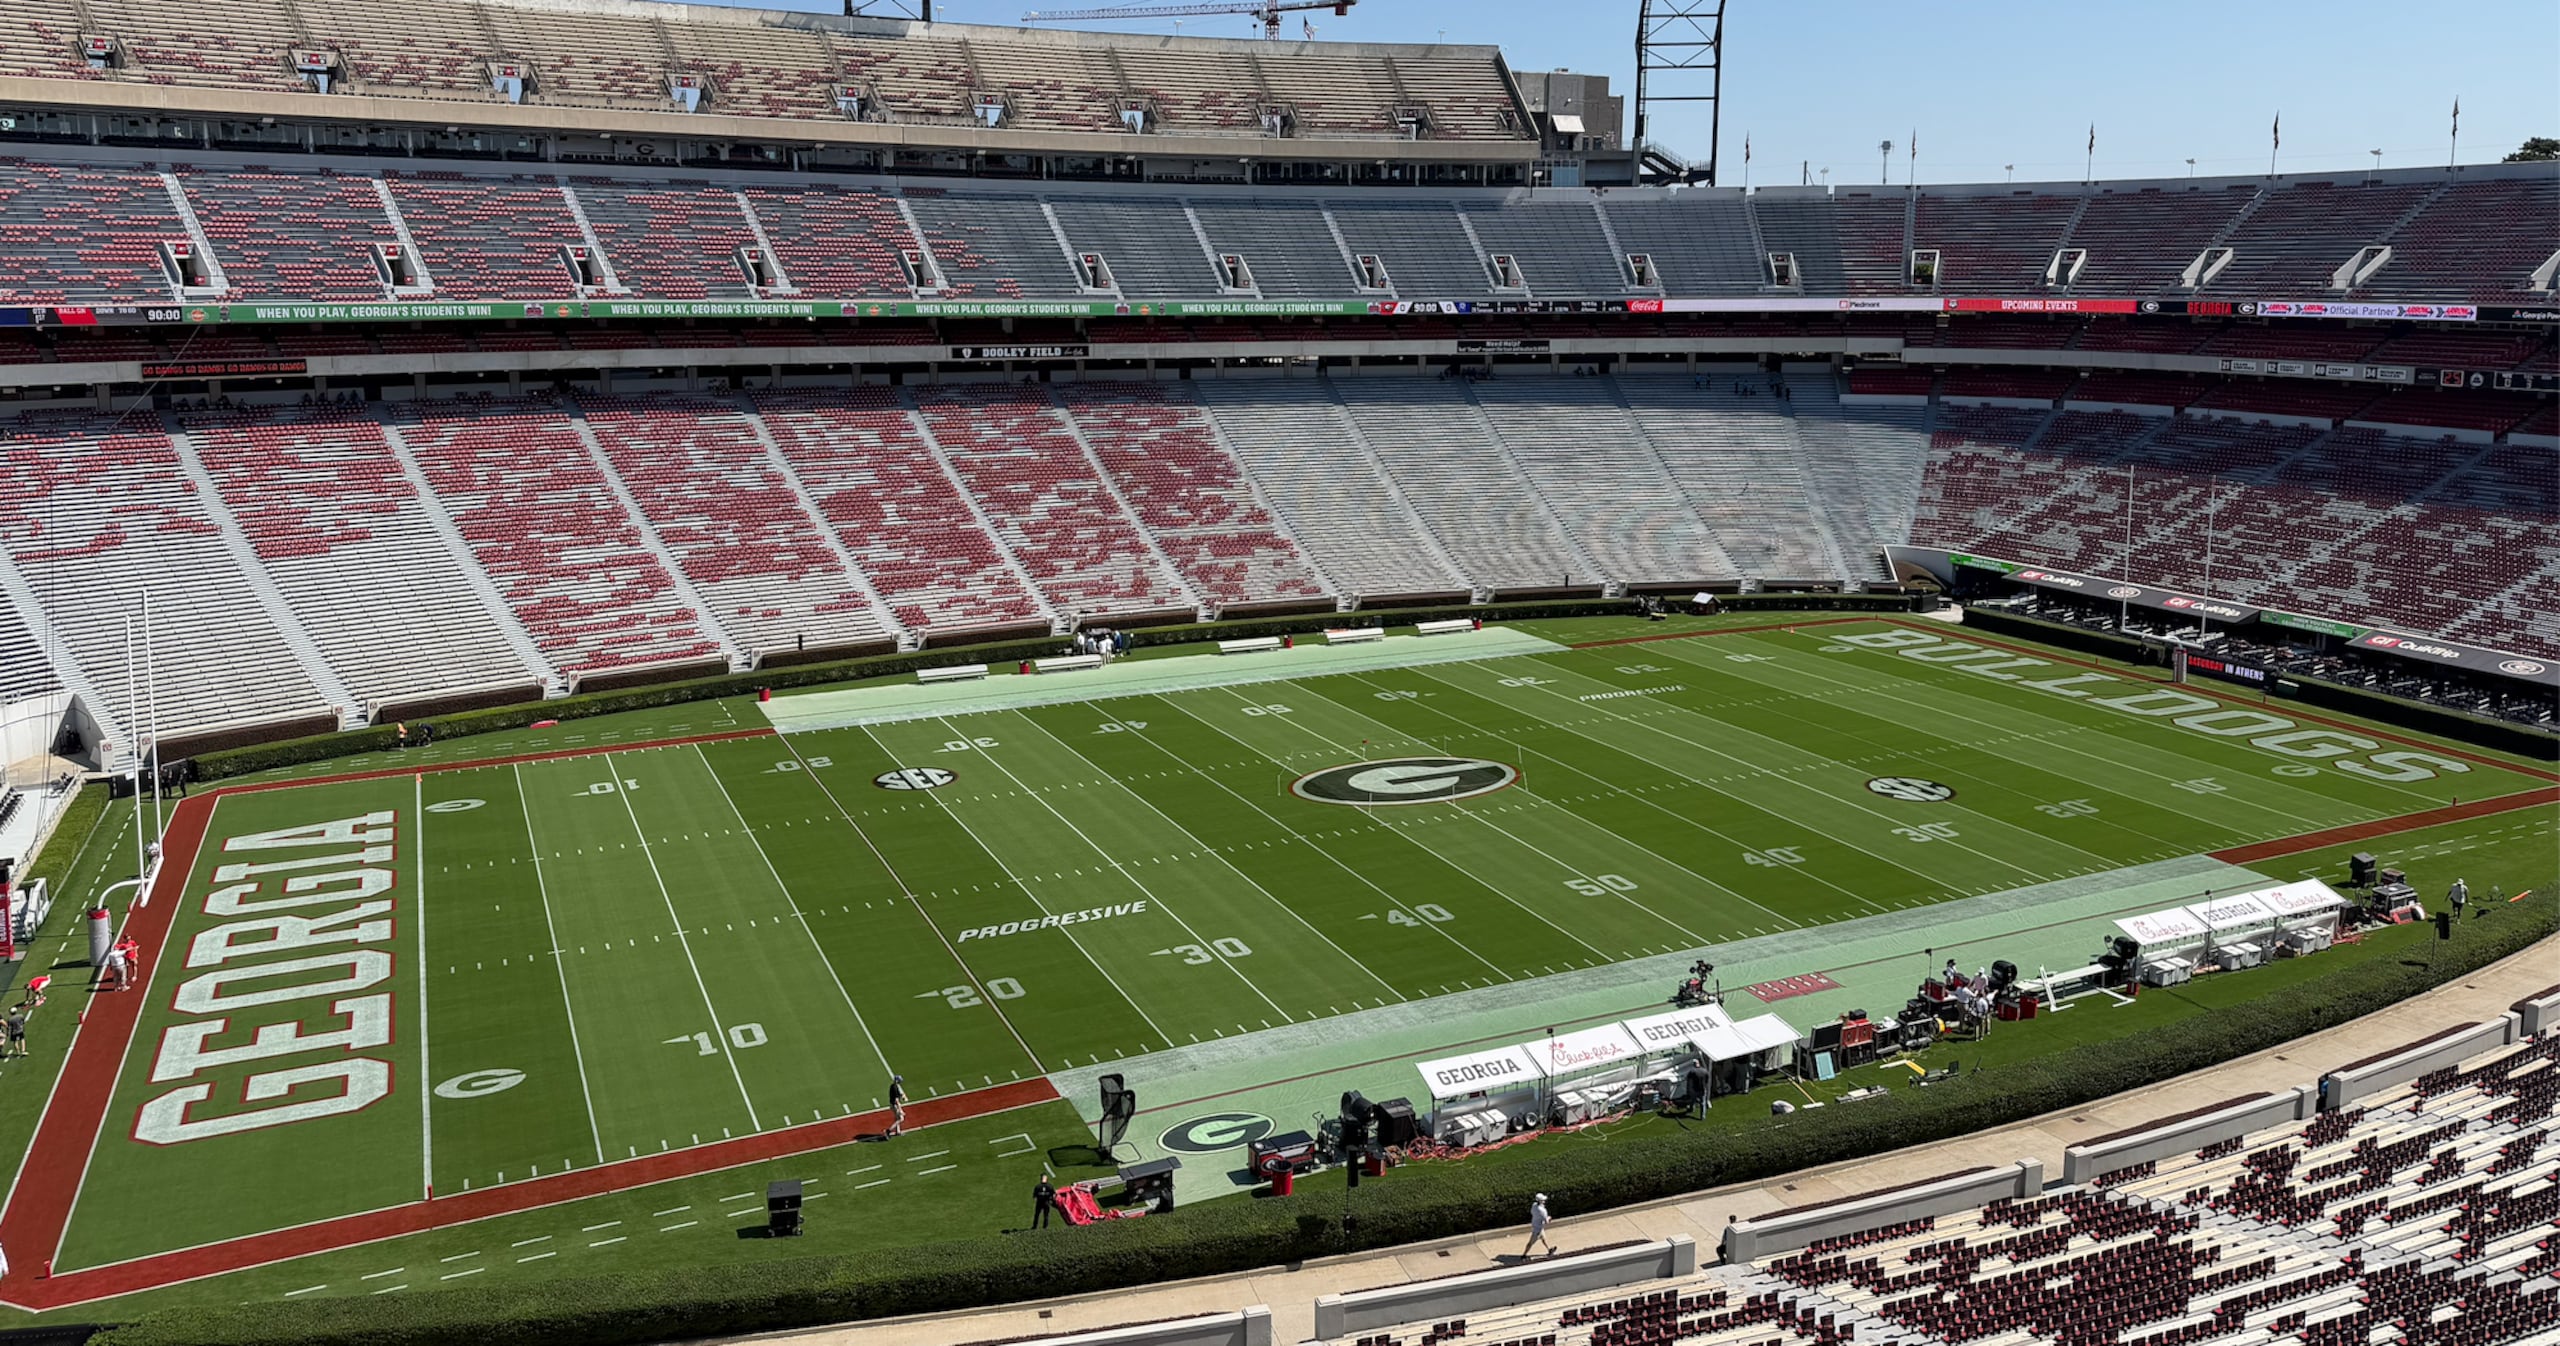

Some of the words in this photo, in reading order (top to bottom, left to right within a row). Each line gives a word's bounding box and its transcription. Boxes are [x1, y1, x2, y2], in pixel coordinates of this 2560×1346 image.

[256, 307, 290, 318] WHEN
[293, 307, 315, 318] YOU
[319, 307, 349, 319] PLAY,
[351, 306, 408, 317] GEORGIA'S
[411, 306, 465, 316] STUDENTS
[467, 305, 491, 315] WIN!
[611, 304, 640, 314] WHEN
[642, 304, 662, 314] YOU
[664, 304, 689, 315] PLAY,
[691, 304, 741, 314] GEORGIA'S
[743, 304, 790, 314] STUDENTS
[792, 303, 813, 313] WIN!
[915, 304, 940, 313] WHEN
[942, 304, 959, 313] YOU
[961, 304, 983, 314] PLAY,
[985, 304, 1028, 313] GEORGIA'S
[1029, 304, 1070, 313] STUDENTS
[1071, 304, 1090, 312] WIN!
[1182, 304, 1204, 312] WHEN
[1206, 304, 1221, 312] YOU
[1223, 304, 1243, 313] PLAY,
[1245, 304, 1284, 312] GEORGIA'S
[1286, 303, 1324, 312] STUDENTS
[1326, 303, 1344, 312] WIN!
[1631, 300, 1659, 311] Coca-Cola
[2001, 300, 2043, 310] UPCOMING
[2045, 300, 2078, 310] EVENTS
[2187, 301, 2232, 315] GEORGIA
[2330, 305, 2358, 315] Official
[2362, 306, 2395, 316] Partner
[148, 309, 180, 321] 90:00
[2522, 311, 2546, 320] Georgia
[982, 347, 1026, 358] DOOLEY
[1030, 347, 1061, 356] FIELD
[2444, 372, 2461, 384] 25
[2371, 636, 2395, 647] QT
[2397, 640, 2461, 658] QuikTrip
[1614, 664, 1661, 675] 20
[2188, 655, 2225, 671] SATURDAY
[2225, 664, 2234, 672] IN
[2235, 664, 2264, 681] ATHENS
[1374, 690, 1418, 701] 40
[1579, 684, 1687, 702] PROGRESSIVE
[1241, 703, 1293, 716] 50
[1829, 629, 2473, 784] BULLDOGS
[1098, 720, 1147, 733] 40
[944, 736, 1000, 752] 30
[775, 756, 833, 772] 20
[2271, 765, 2319, 777] G
[588, 778, 641, 795] 10
[875, 767, 956, 790] SEC
[1300, 757, 1508, 804] G
[1867, 777, 1953, 802] SEC
[425, 798, 487, 812] G
[2034, 800, 2100, 818] 20
[1891, 823, 1960, 842] 30
[1742, 848, 1806, 867] 40
[1563, 874, 1638, 896] 50
[1387, 904, 1455, 927] 40
[2202, 902, 2262, 922] GEORGIA
[957, 900, 1148, 943] PROGRESSIVE
[1173, 937, 1253, 966] 30
[132, 809, 396, 1145] GEORGIA
[941, 976, 1026, 1009] 20
[1643, 1015, 1721, 1041] GEORGIA
[693, 1022, 768, 1056] 10
[1436, 1057, 1522, 1086] GEORGIA
[434, 1068, 527, 1098] G
[1160, 1113, 1275, 1153] G
